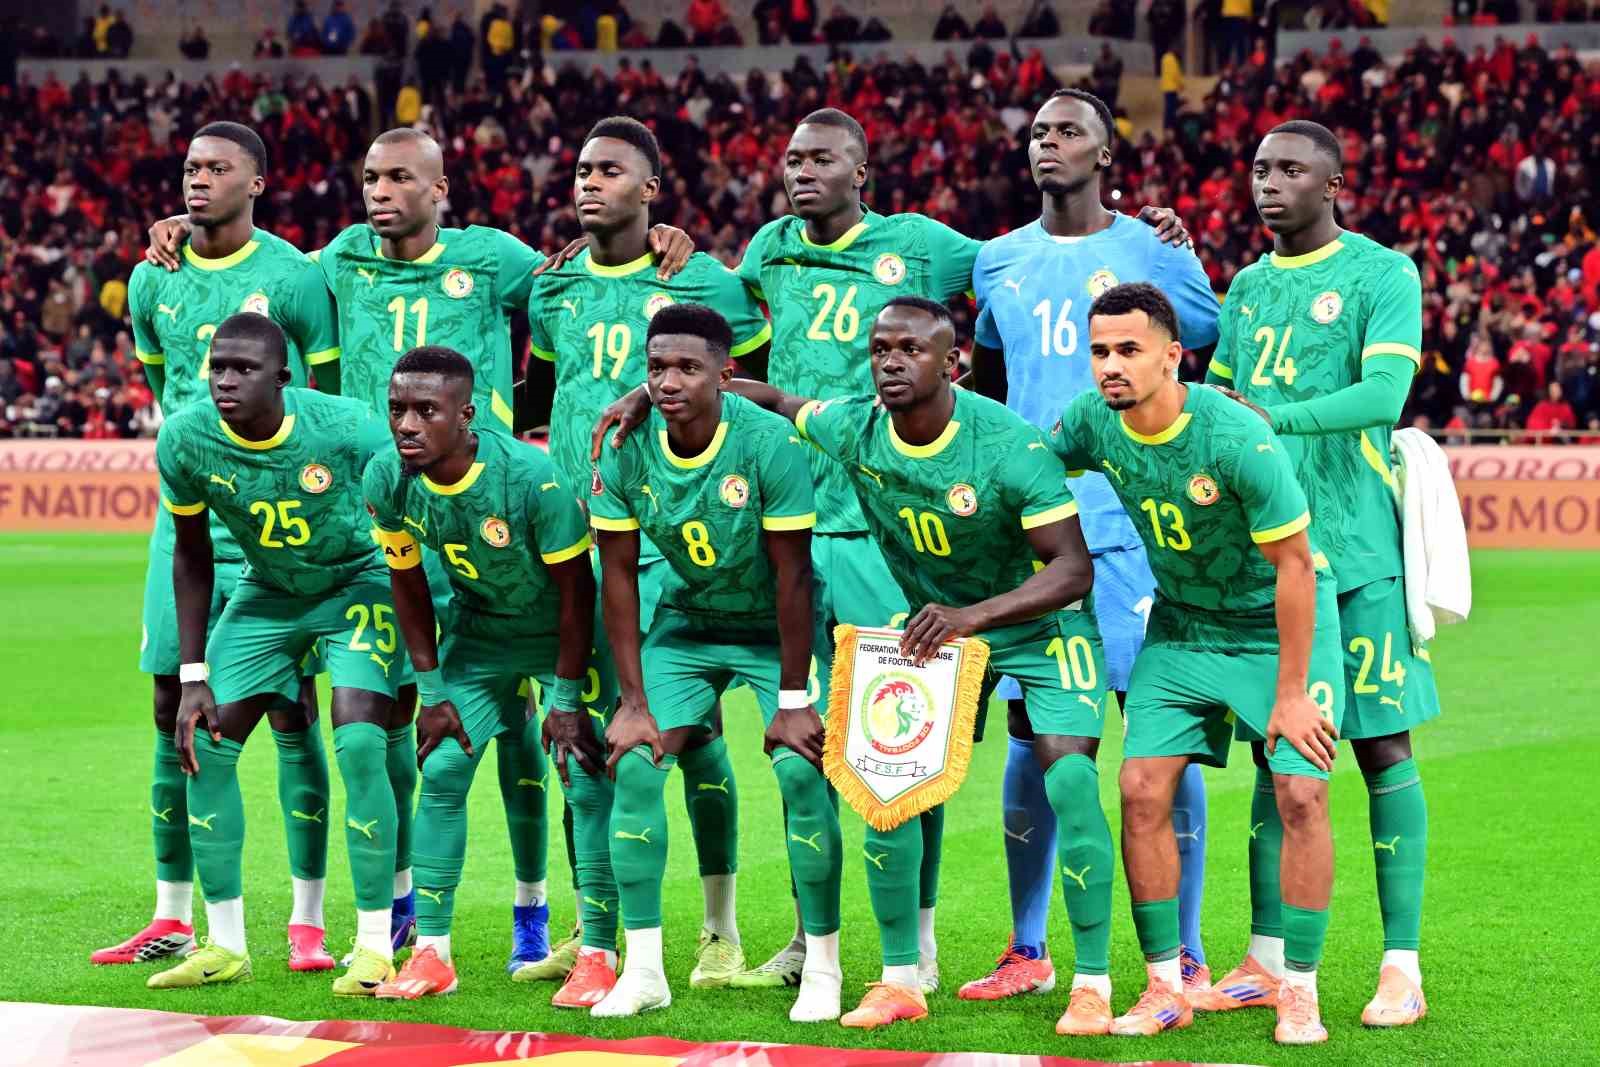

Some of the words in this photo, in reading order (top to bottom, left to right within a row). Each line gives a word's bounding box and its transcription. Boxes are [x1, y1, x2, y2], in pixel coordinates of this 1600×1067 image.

[387, 295, 429, 353] 11
[807, 283, 860, 343] 26
[1032, 298, 1078, 356] 16
[587, 321, 632, 380] 19
[1251, 325, 1297, 386] 24
[250, 500, 311, 548] 25
[681, 521, 717, 567] 8
[898, 507, 952, 557] 10
[1140, 498, 1192, 551] 13
[443, 543, 479, 580] 5
[345, 603, 397, 654] 25
[878, 656, 887, 665] DE
[1046, 635, 1097, 690] 10
[1349, 631, 1407, 694] 24
